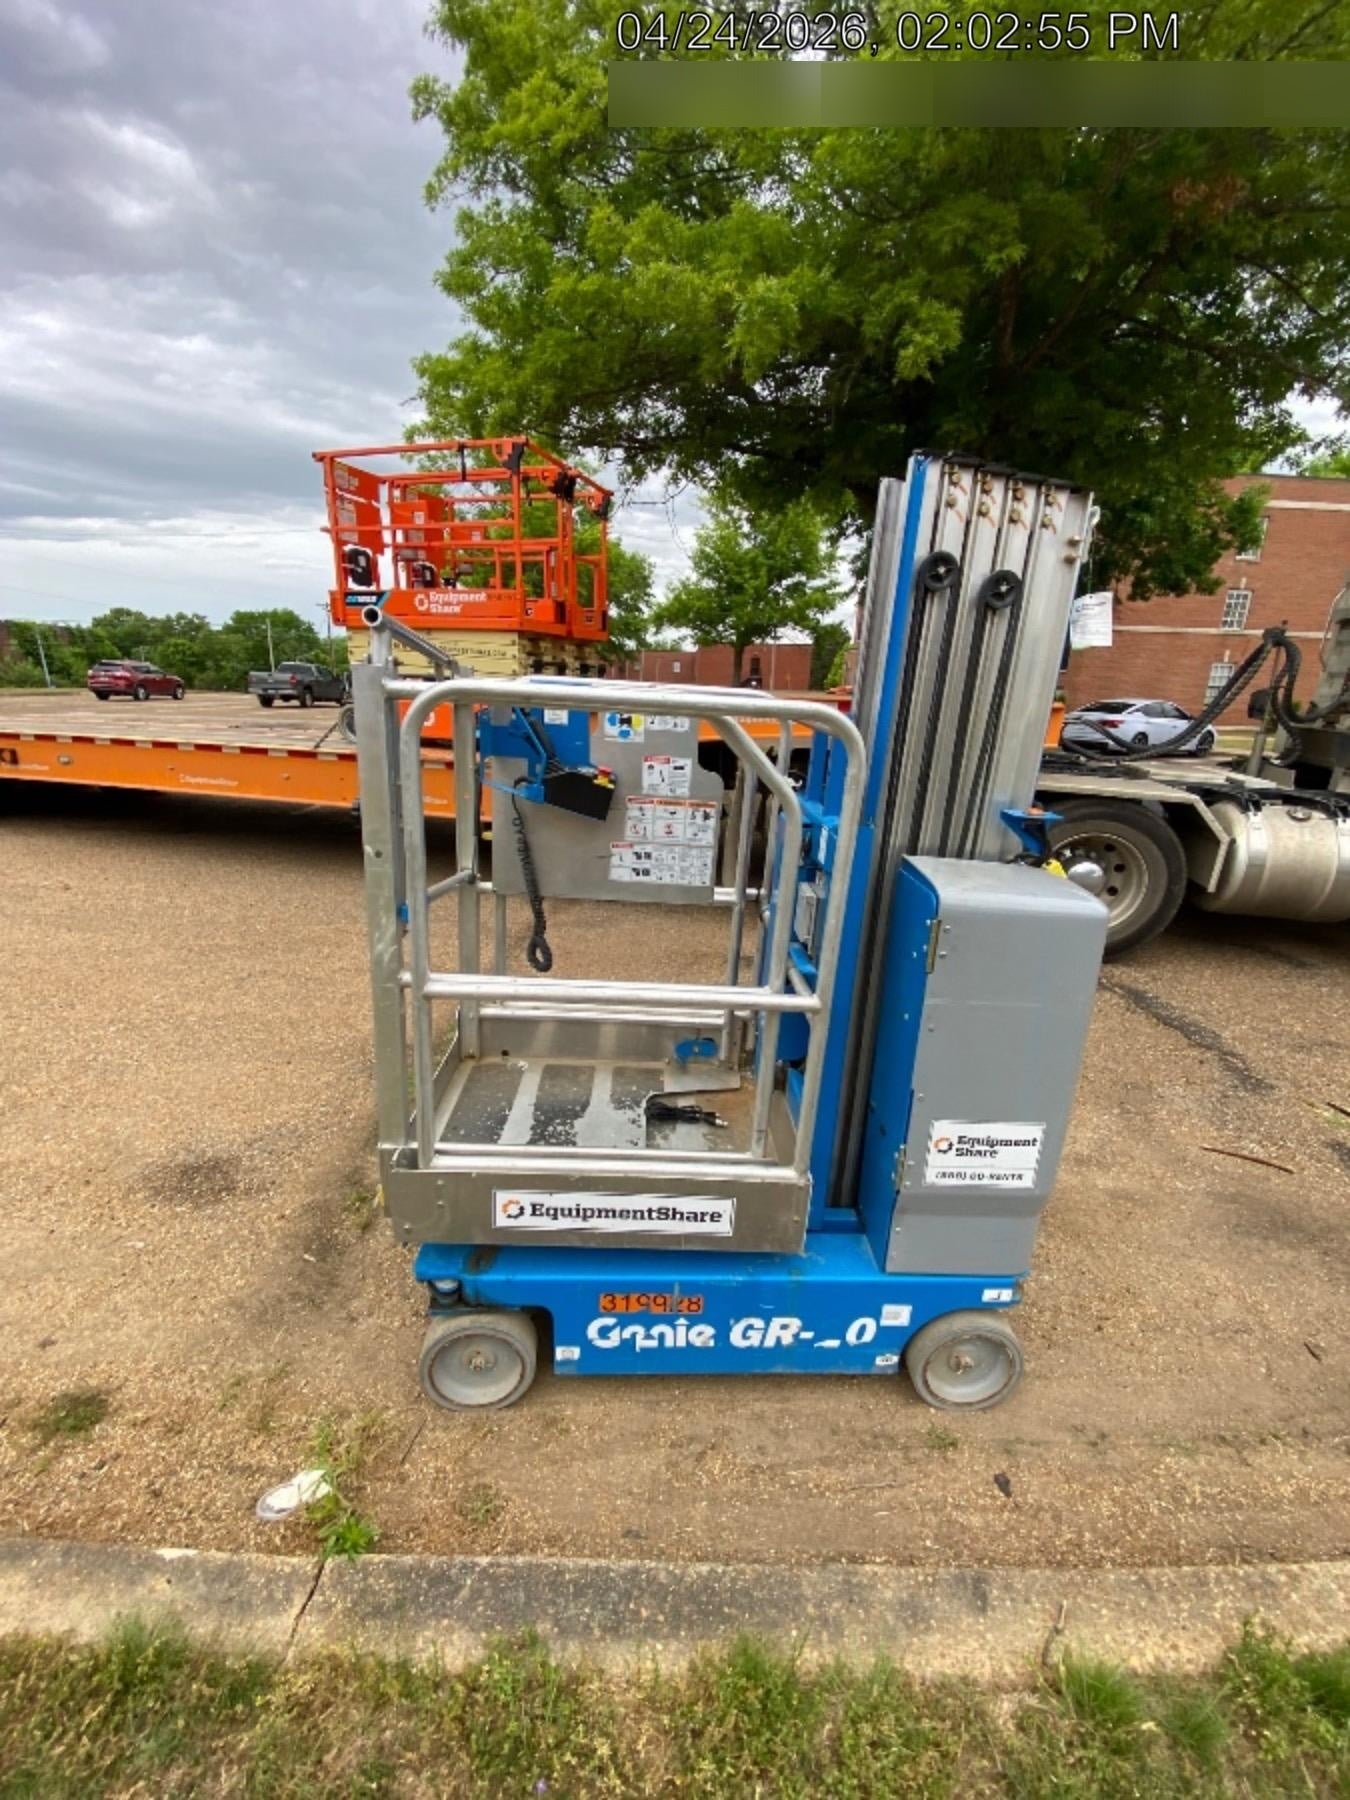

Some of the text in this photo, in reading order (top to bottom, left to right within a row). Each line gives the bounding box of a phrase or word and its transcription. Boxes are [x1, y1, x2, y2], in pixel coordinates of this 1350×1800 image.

[956, 1135, 1038, 1149] Equipment
[955, 1148, 998, 1158] Share
[529, 1203, 723, 1223] EquipmentShare
[729, 1317, 876, 1348] GR-0
